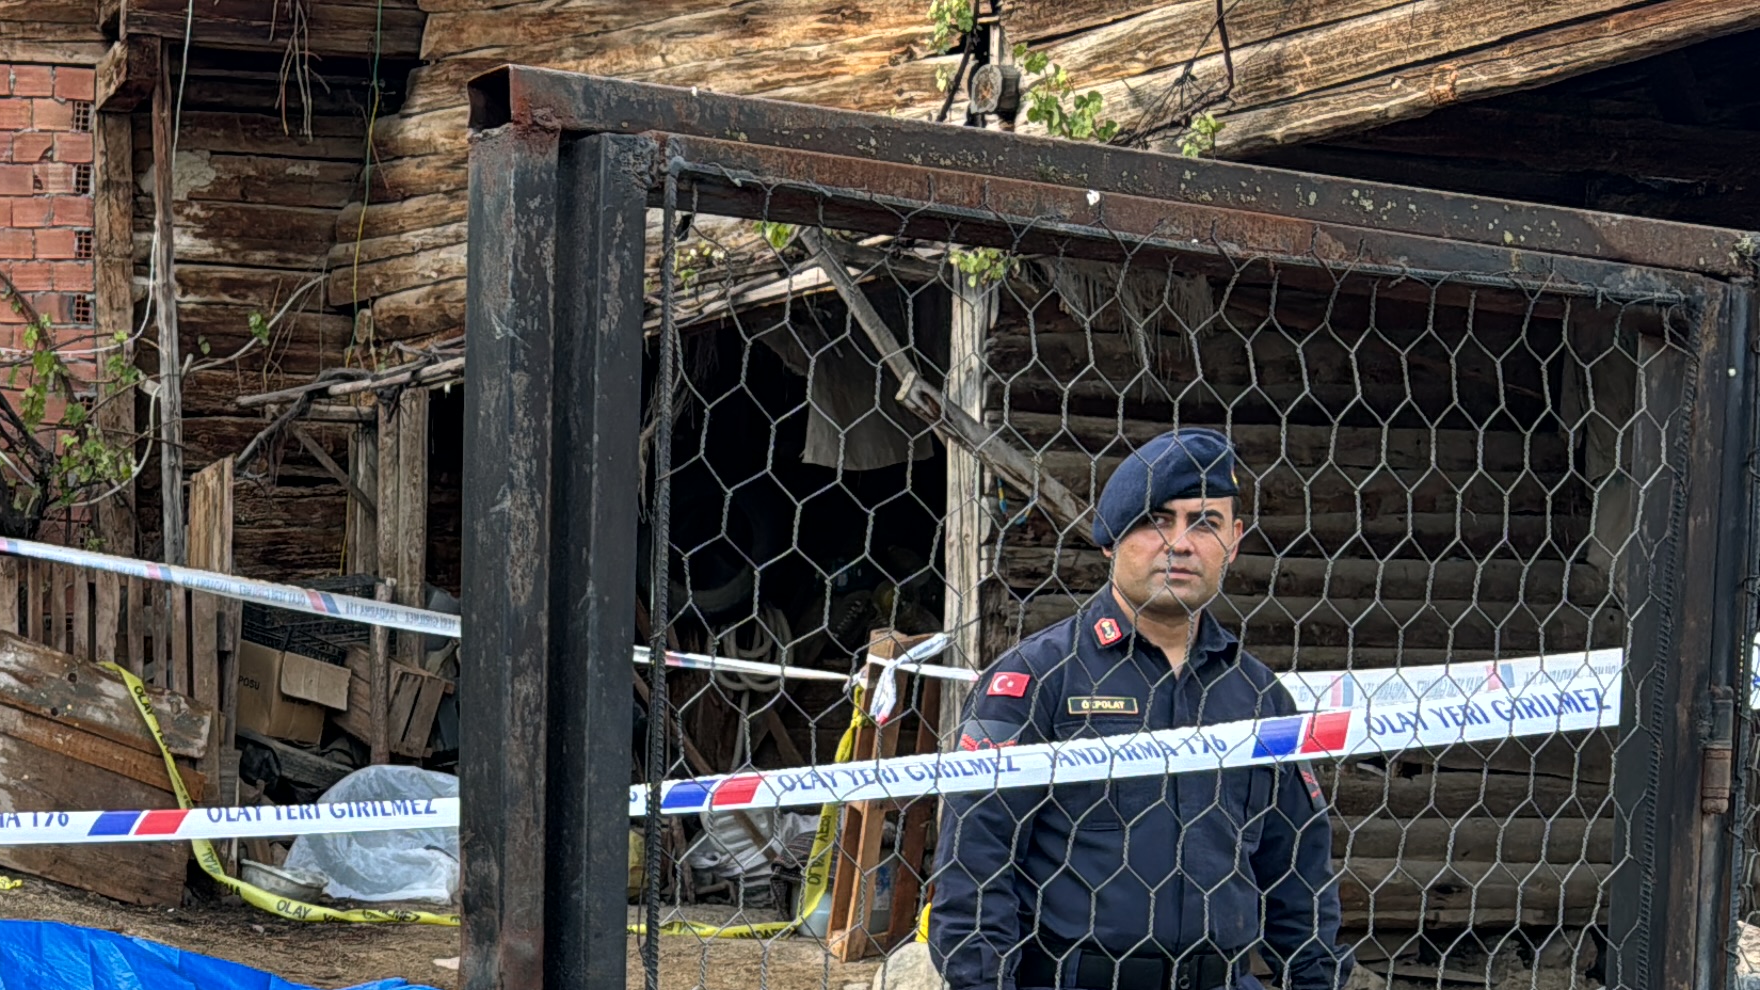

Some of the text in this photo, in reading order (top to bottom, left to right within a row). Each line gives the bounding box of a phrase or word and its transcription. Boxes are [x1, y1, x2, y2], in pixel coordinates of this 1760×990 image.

[1364, 710, 1429, 735] OLAY
[777, 769, 839, 792] OLAY
[276, 899, 312, 920] OLAY
